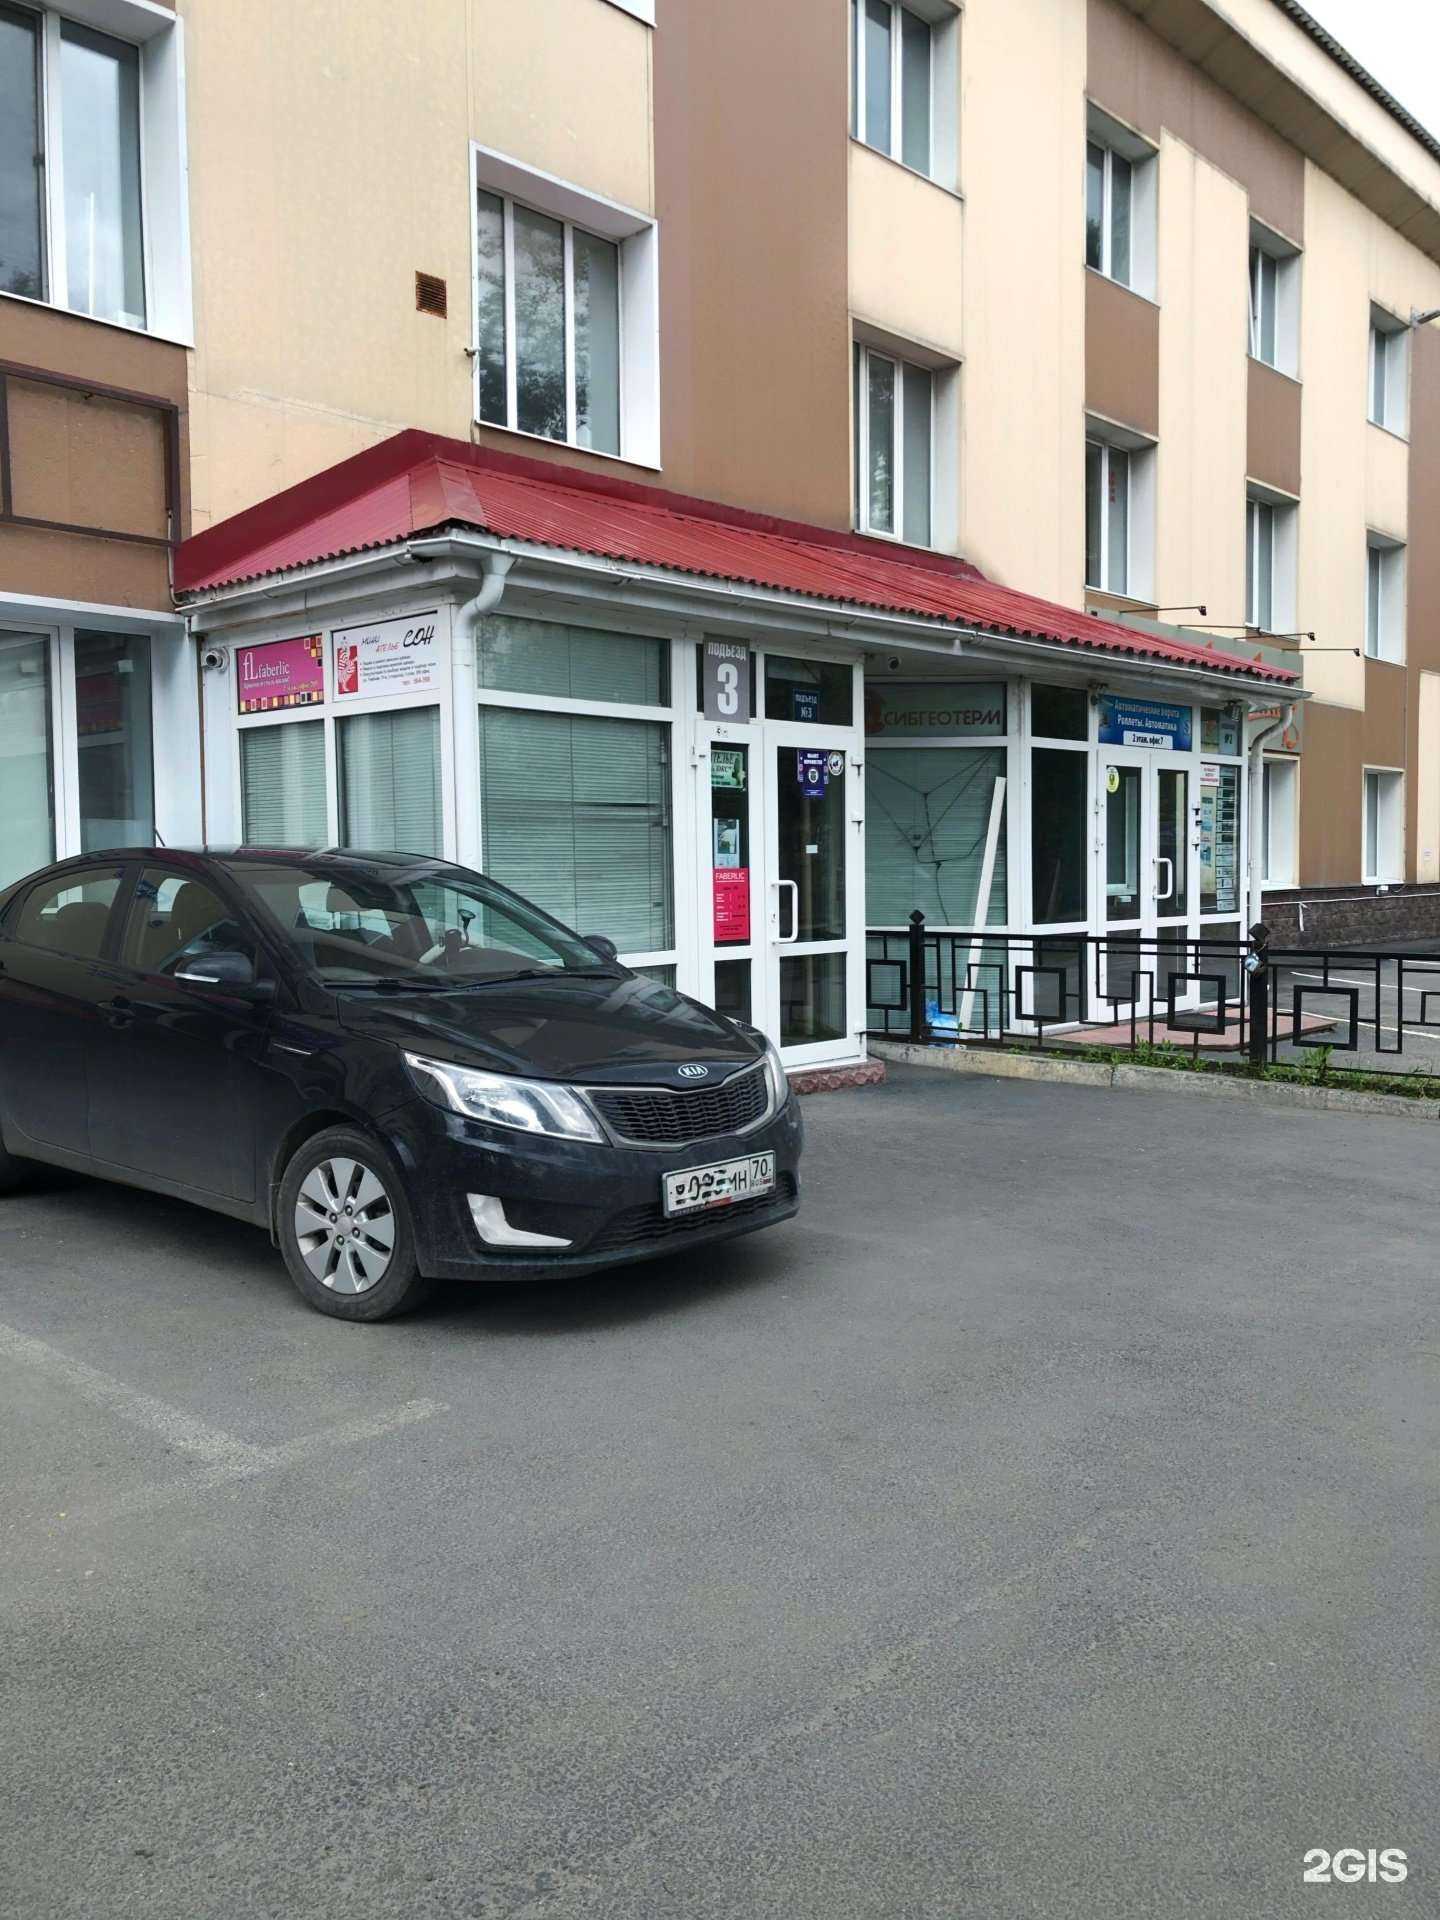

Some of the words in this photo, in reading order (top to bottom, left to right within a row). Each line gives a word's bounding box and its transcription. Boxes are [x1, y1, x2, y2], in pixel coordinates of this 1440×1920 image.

[403, 625, 435, 648] СОН
[258, 660, 290, 678] faberlic
[717, 663, 738, 715] 3
[884, 709, 1001, 726] СИБГЕОТЕРМ
[715, 872, 745, 881] FABERLIC
[683, 1066, 705, 1077] KIA
[752, 1158, 768, 1180] 70
